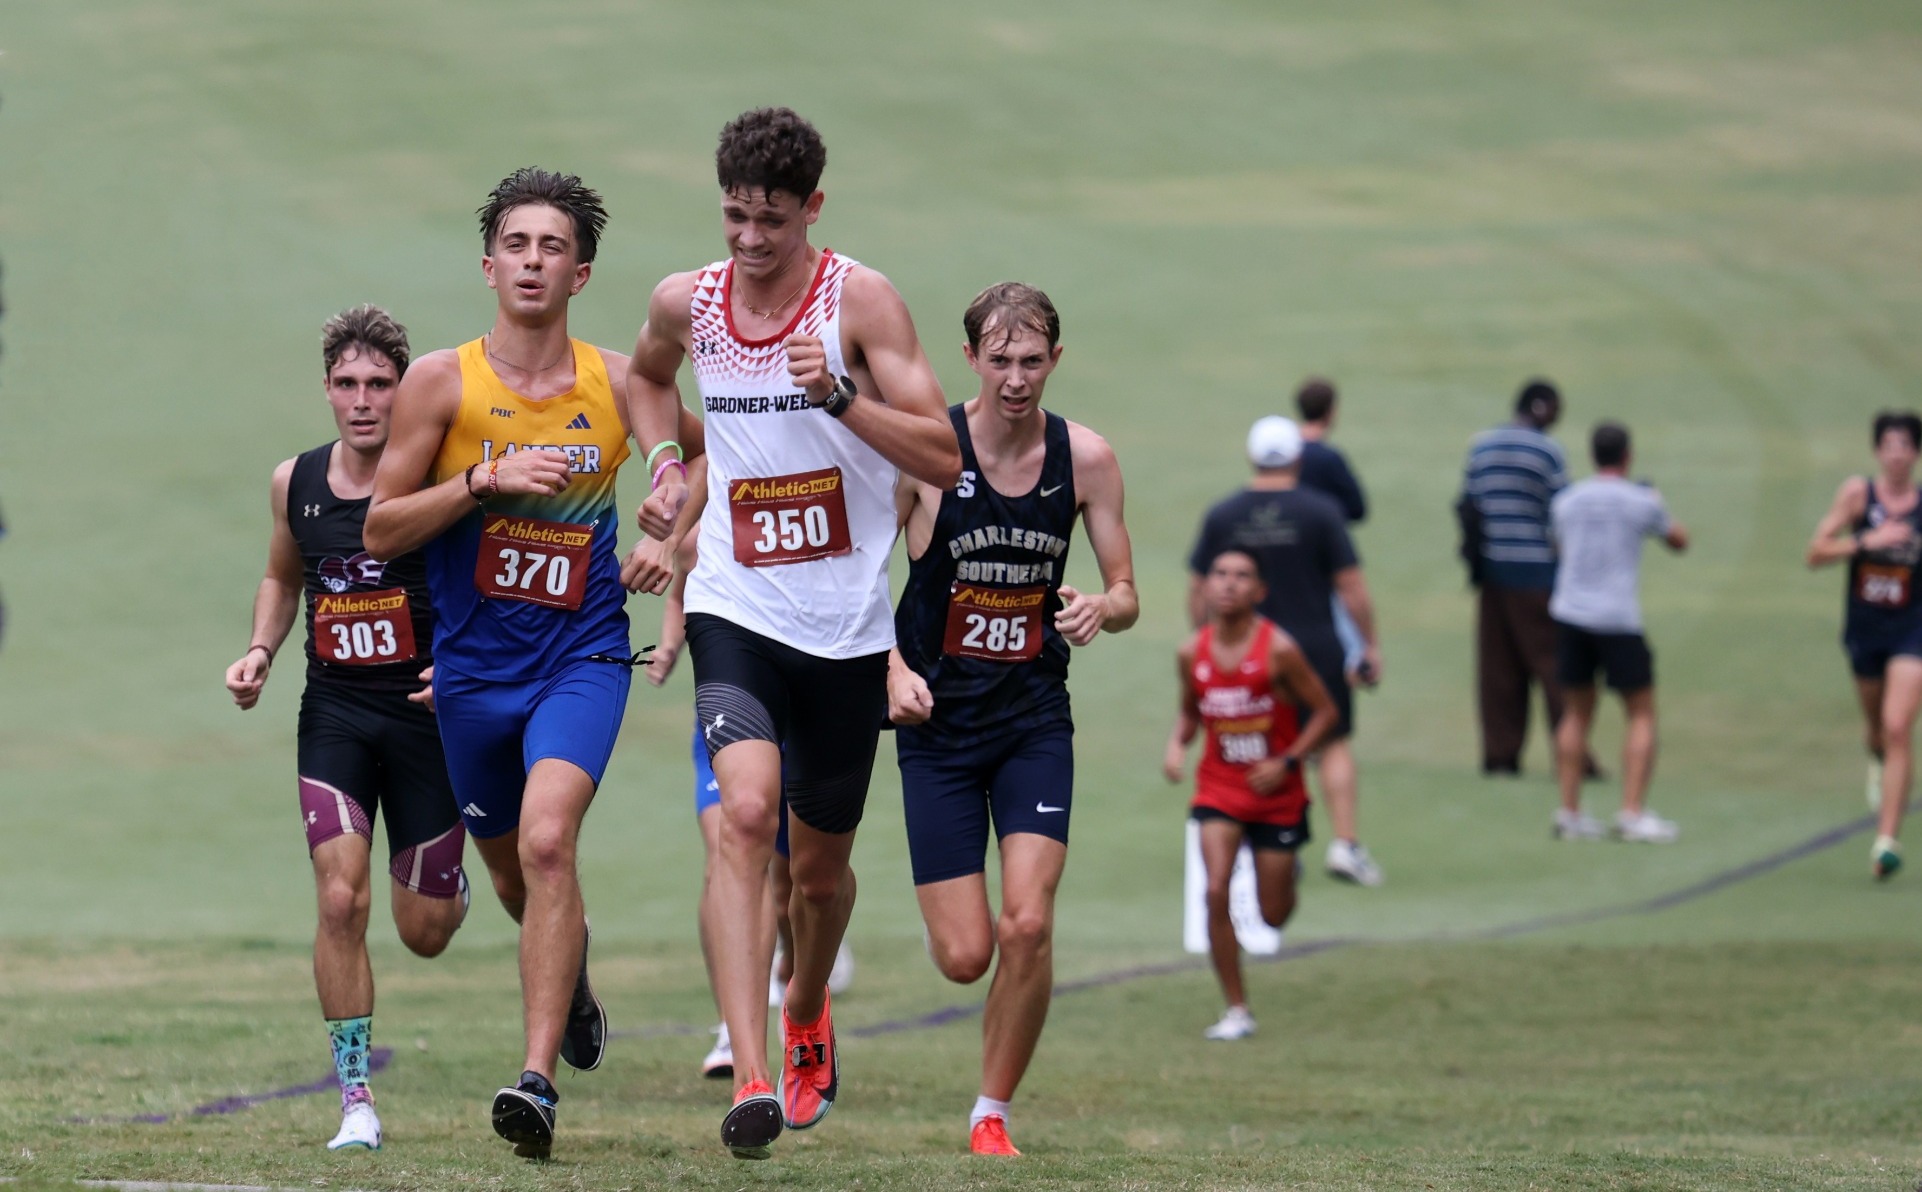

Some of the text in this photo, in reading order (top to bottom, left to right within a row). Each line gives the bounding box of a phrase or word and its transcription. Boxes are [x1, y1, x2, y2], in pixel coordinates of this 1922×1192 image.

[490, 407, 516, 418] PBC
[705, 394, 819, 414] GARDNER-WEB
[482, 440, 600, 473] LAER
[752, 505, 830, 553] 350
[948, 525, 1068, 559] CHARLESTON
[495, 548, 570, 596] 370
[331, 620, 397, 660] 303
[962, 613, 1028, 652] 285
